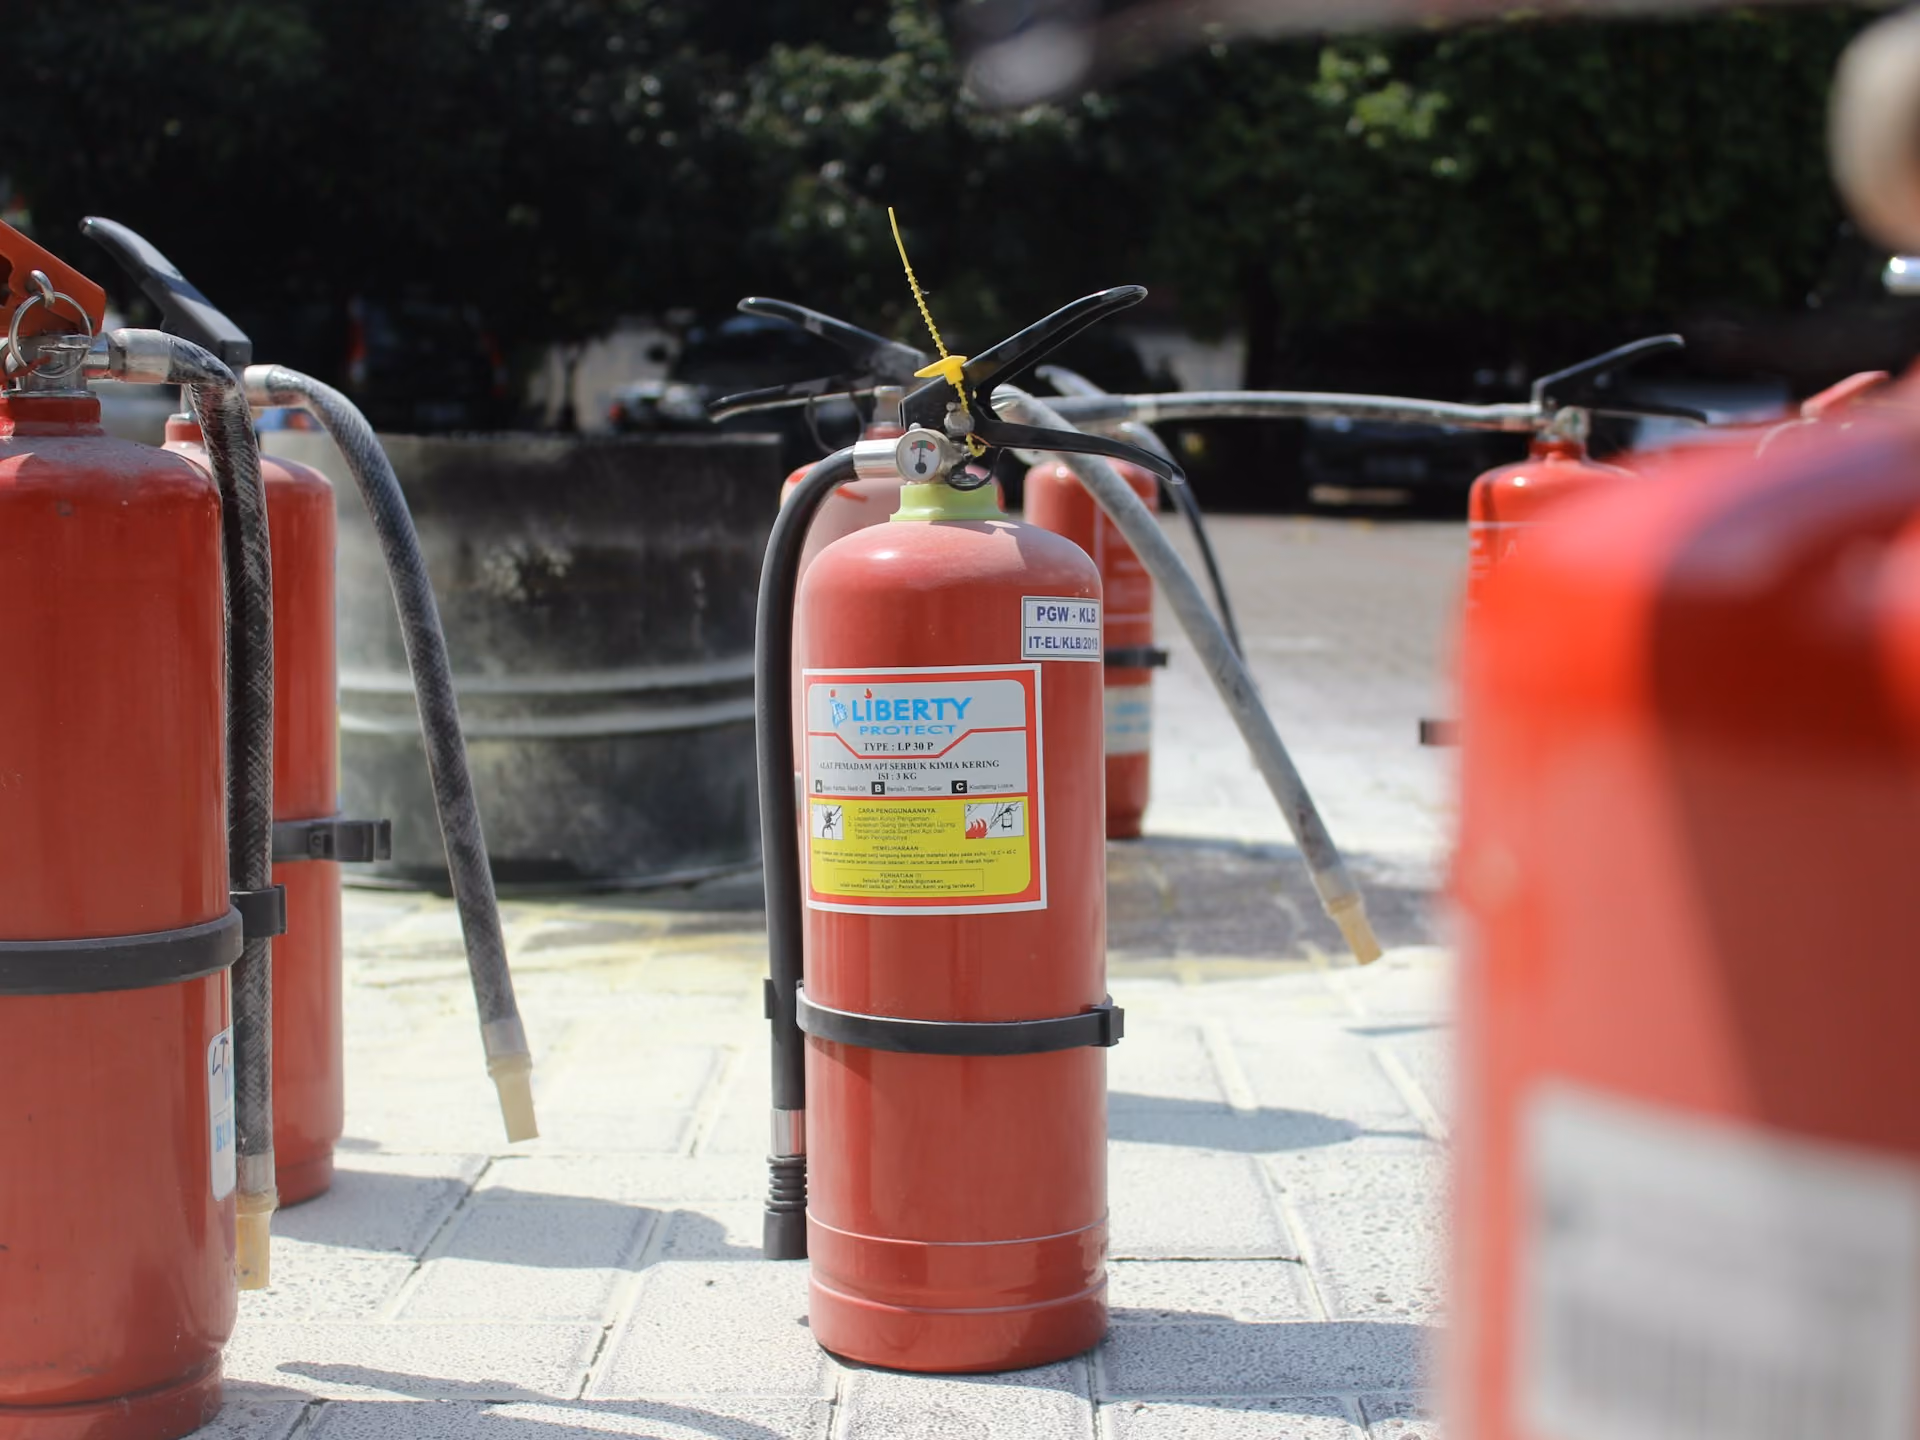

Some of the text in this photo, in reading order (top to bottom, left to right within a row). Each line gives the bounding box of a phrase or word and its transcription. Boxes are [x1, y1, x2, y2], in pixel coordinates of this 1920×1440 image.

[1037, 606, 1069, 622] PGW
[1079, 607, 1096, 623] KLB
[852, 697, 972, 721] LIBERTY
[859, 724, 957, 736] PROTECT
[864, 742, 889, 751] TYPE
[897, 742, 911, 751] LP
[913, 742, 924, 751] 30
[927, 742, 934, 751] P
[834, 762, 872, 771] PEMADAM
[874, 762, 888, 770] API
[889, 762, 926, 770] SERBUK
[929, 761, 959, 770] KIMIA
[962, 760, 1000, 769] KERING
[878, 772, 889, 780] ISI
[896, 772, 901, 780] 3
[903, 772, 917, 780] KG
